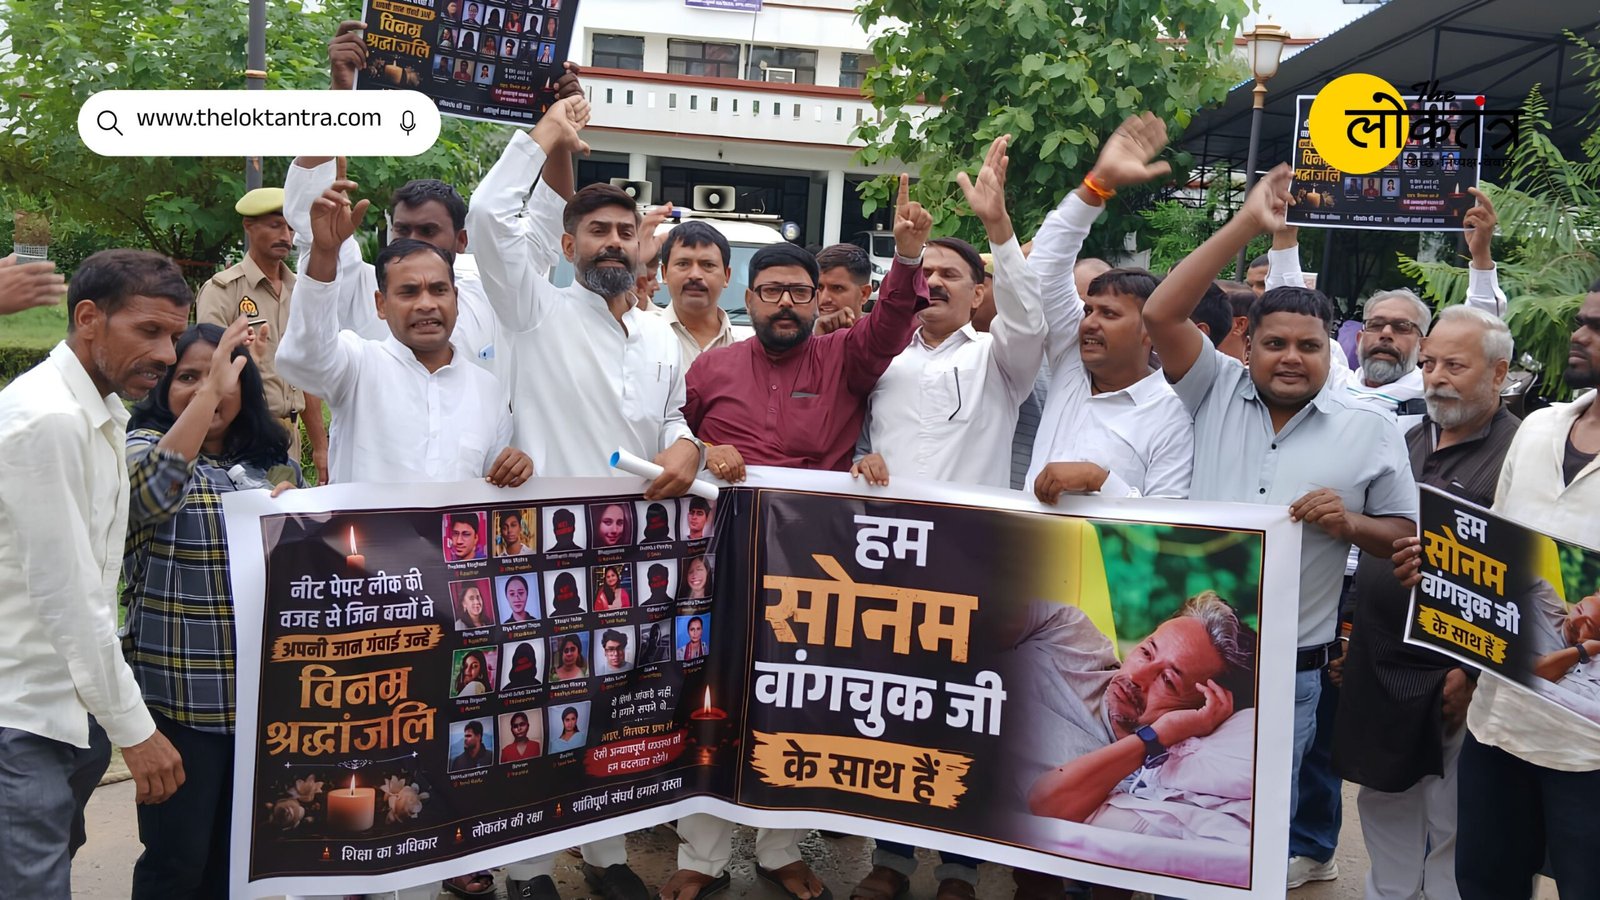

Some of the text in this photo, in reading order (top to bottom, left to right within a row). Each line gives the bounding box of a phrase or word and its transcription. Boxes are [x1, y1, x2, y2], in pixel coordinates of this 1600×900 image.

[367, 32, 431, 58] श्रद्धांजलि
[380, 12, 424, 39] विनम्र
[854, 514, 934, 570] हम
[1454, 509, 1488, 544] हम
[1424, 524, 1507, 597] सोनम
[290, 575, 325, 599] नीट
[329, 574, 364, 598] पेपर
[368, 570, 401, 595] लीक
[403, 567, 423, 591] की
[1420, 569, 1521, 635] वांगचुक जी
[280, 595, 434, 628] वजह से जिन बच्चों ने
[763, 554, 979, 663] सोनम
[281, 627, 433, 657] अपनी जान गंवाई उन्हें
[1432, 612, 1496, 659] के साथ हैं
[299, 664, 413, 709] विनम्र
[754, 648, 1007, 738] वांगचुक जी
[266, 700, 437, 756] श्रद्धांजलि
[783, 739, 941, 804] के साथ हैं
[572, 792, 608, 813] शांतिपूर्ण
[637, 783, 659, 798] हमारा
[661, 777, 682, 792] रास्ता
[472, 810, 543, 838] लोकतंत्र की रक्षा
[341, 836, 438, 861] शिक्षा का अधिकार
